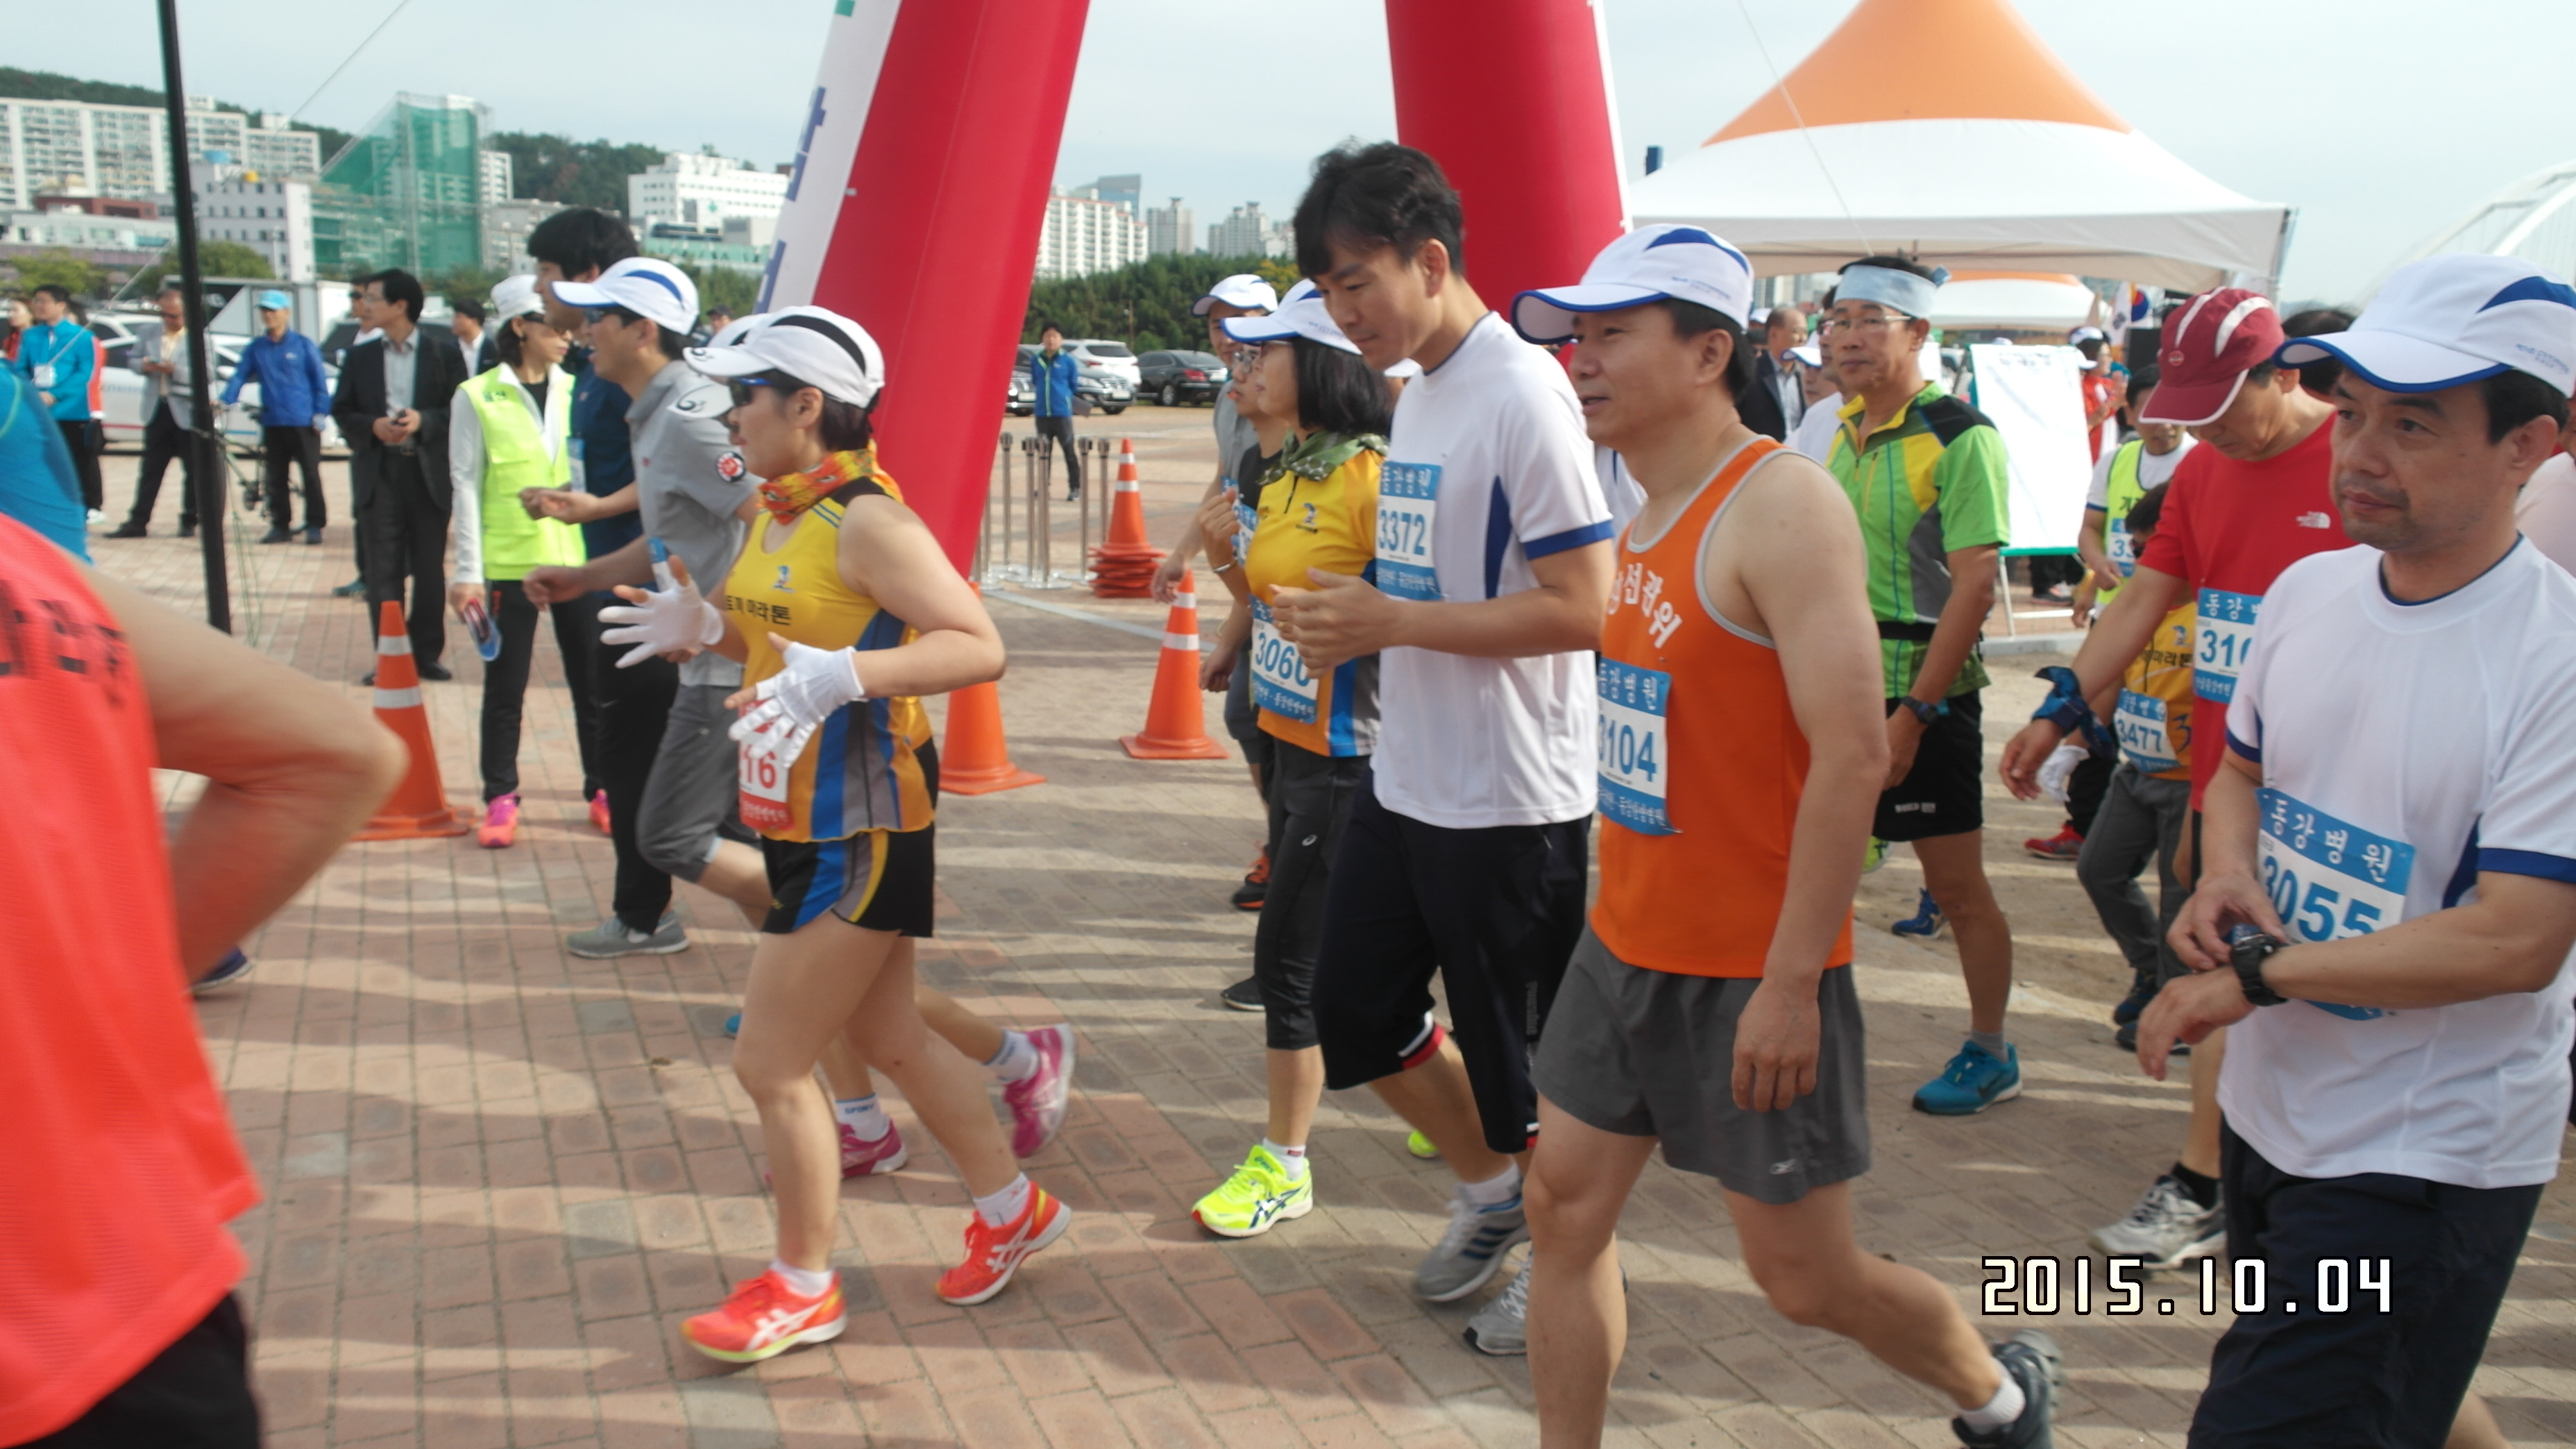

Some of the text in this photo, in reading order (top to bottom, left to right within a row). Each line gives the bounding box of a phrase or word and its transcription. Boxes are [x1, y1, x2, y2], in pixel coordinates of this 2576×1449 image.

[1377, 509, 1426, 556] 3372
[2117, 719, 2162, 754] 3477
[2271, 799, 2392, 883] 동강병원
[2264, 855, 2382, 942] 3055
